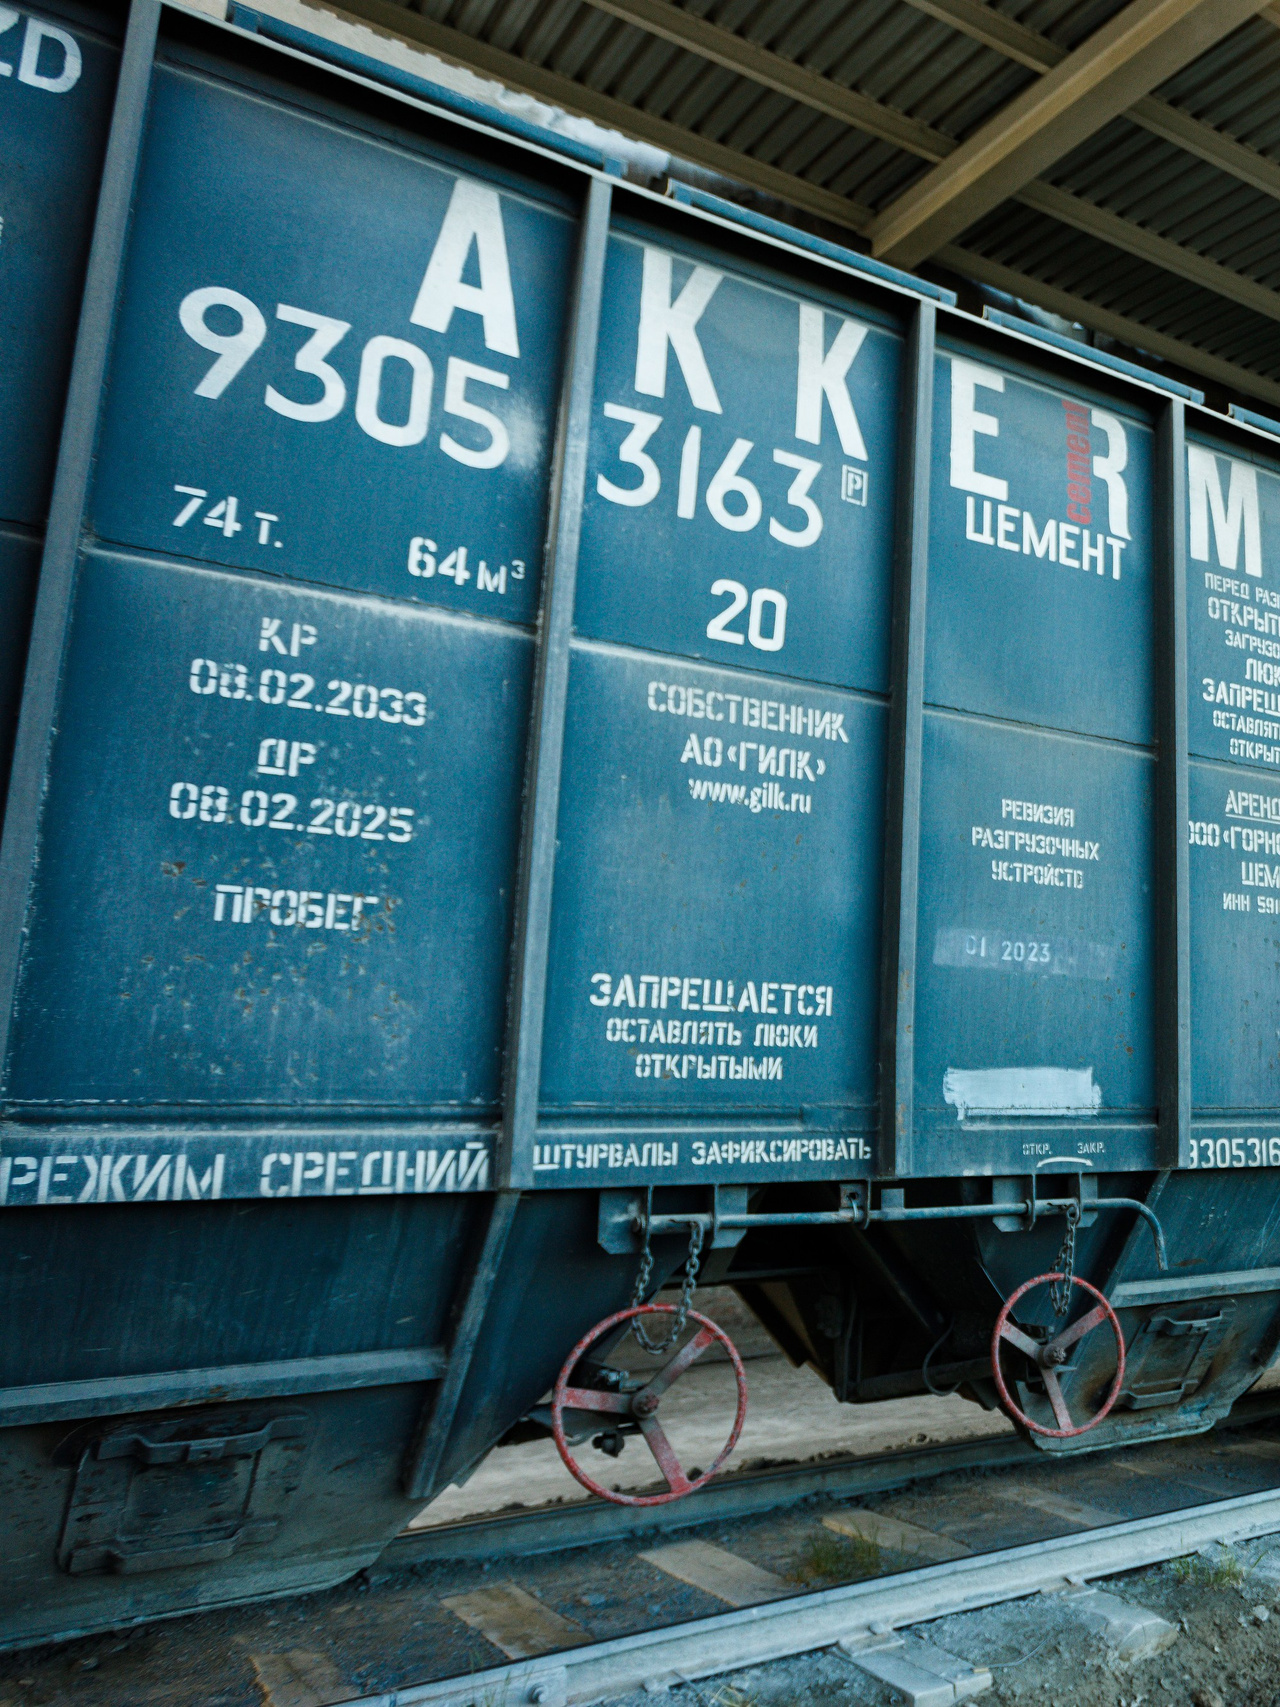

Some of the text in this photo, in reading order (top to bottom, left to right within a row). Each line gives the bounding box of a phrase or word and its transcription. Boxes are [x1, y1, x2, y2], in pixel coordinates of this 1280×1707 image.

[0, 5, 82, 93] D
[179, 286, 510, 469] 9305
[597, 402, 823, 547] 3163
[173, 484, 240, 537] 74
[965, 495, 1127, 580] ЦЕМЕНТ
[1205, 572, 1249, 600] ПЕРЕД
[706, 578, 787, 652] 20
[259, 617, 318, 657] КР
[189, 658, 428, 726] 08.02.2033
[648, 681, 849, 743] СОБСТВЕННИК
[257, 738, 316, 777] ДР
[680, 733, 827, 782] АО «ГИЛК»
[688, 779, 811, 813] www.gilk.ru
[1001, 799, 1075, 828] РЕВИЗИЯ
[972, 826, 1099, 861] РАЗГРУЗОЧНЫХ
[991, 860, 1084, 889] УСТРОЙСТВ
[214, 884, 379, 931] ПРОБЕГ
[1222, 892, 1250, 912] ИНН
[1001, 940, 1051, 963] 2023
[589, 972, 833, 1017] ЗАПРЕЩАЕТСЯ
[606, 1017, 819, 1048] ОСТАВЛЯТЬ ЛЮКИ
[635, 1053, 783, 1081] ОТКРЫТЫМИ
[532, 1137, 871, 1171] ШТУРВАЛЫ ЗАФИКСИРОВАТЬ
[1022, 1140, 1106, 1156] ОТКР. ЗАКР.
[0, 1142, 490, 1205] РЕЖИМ СРЕДНИЙ
